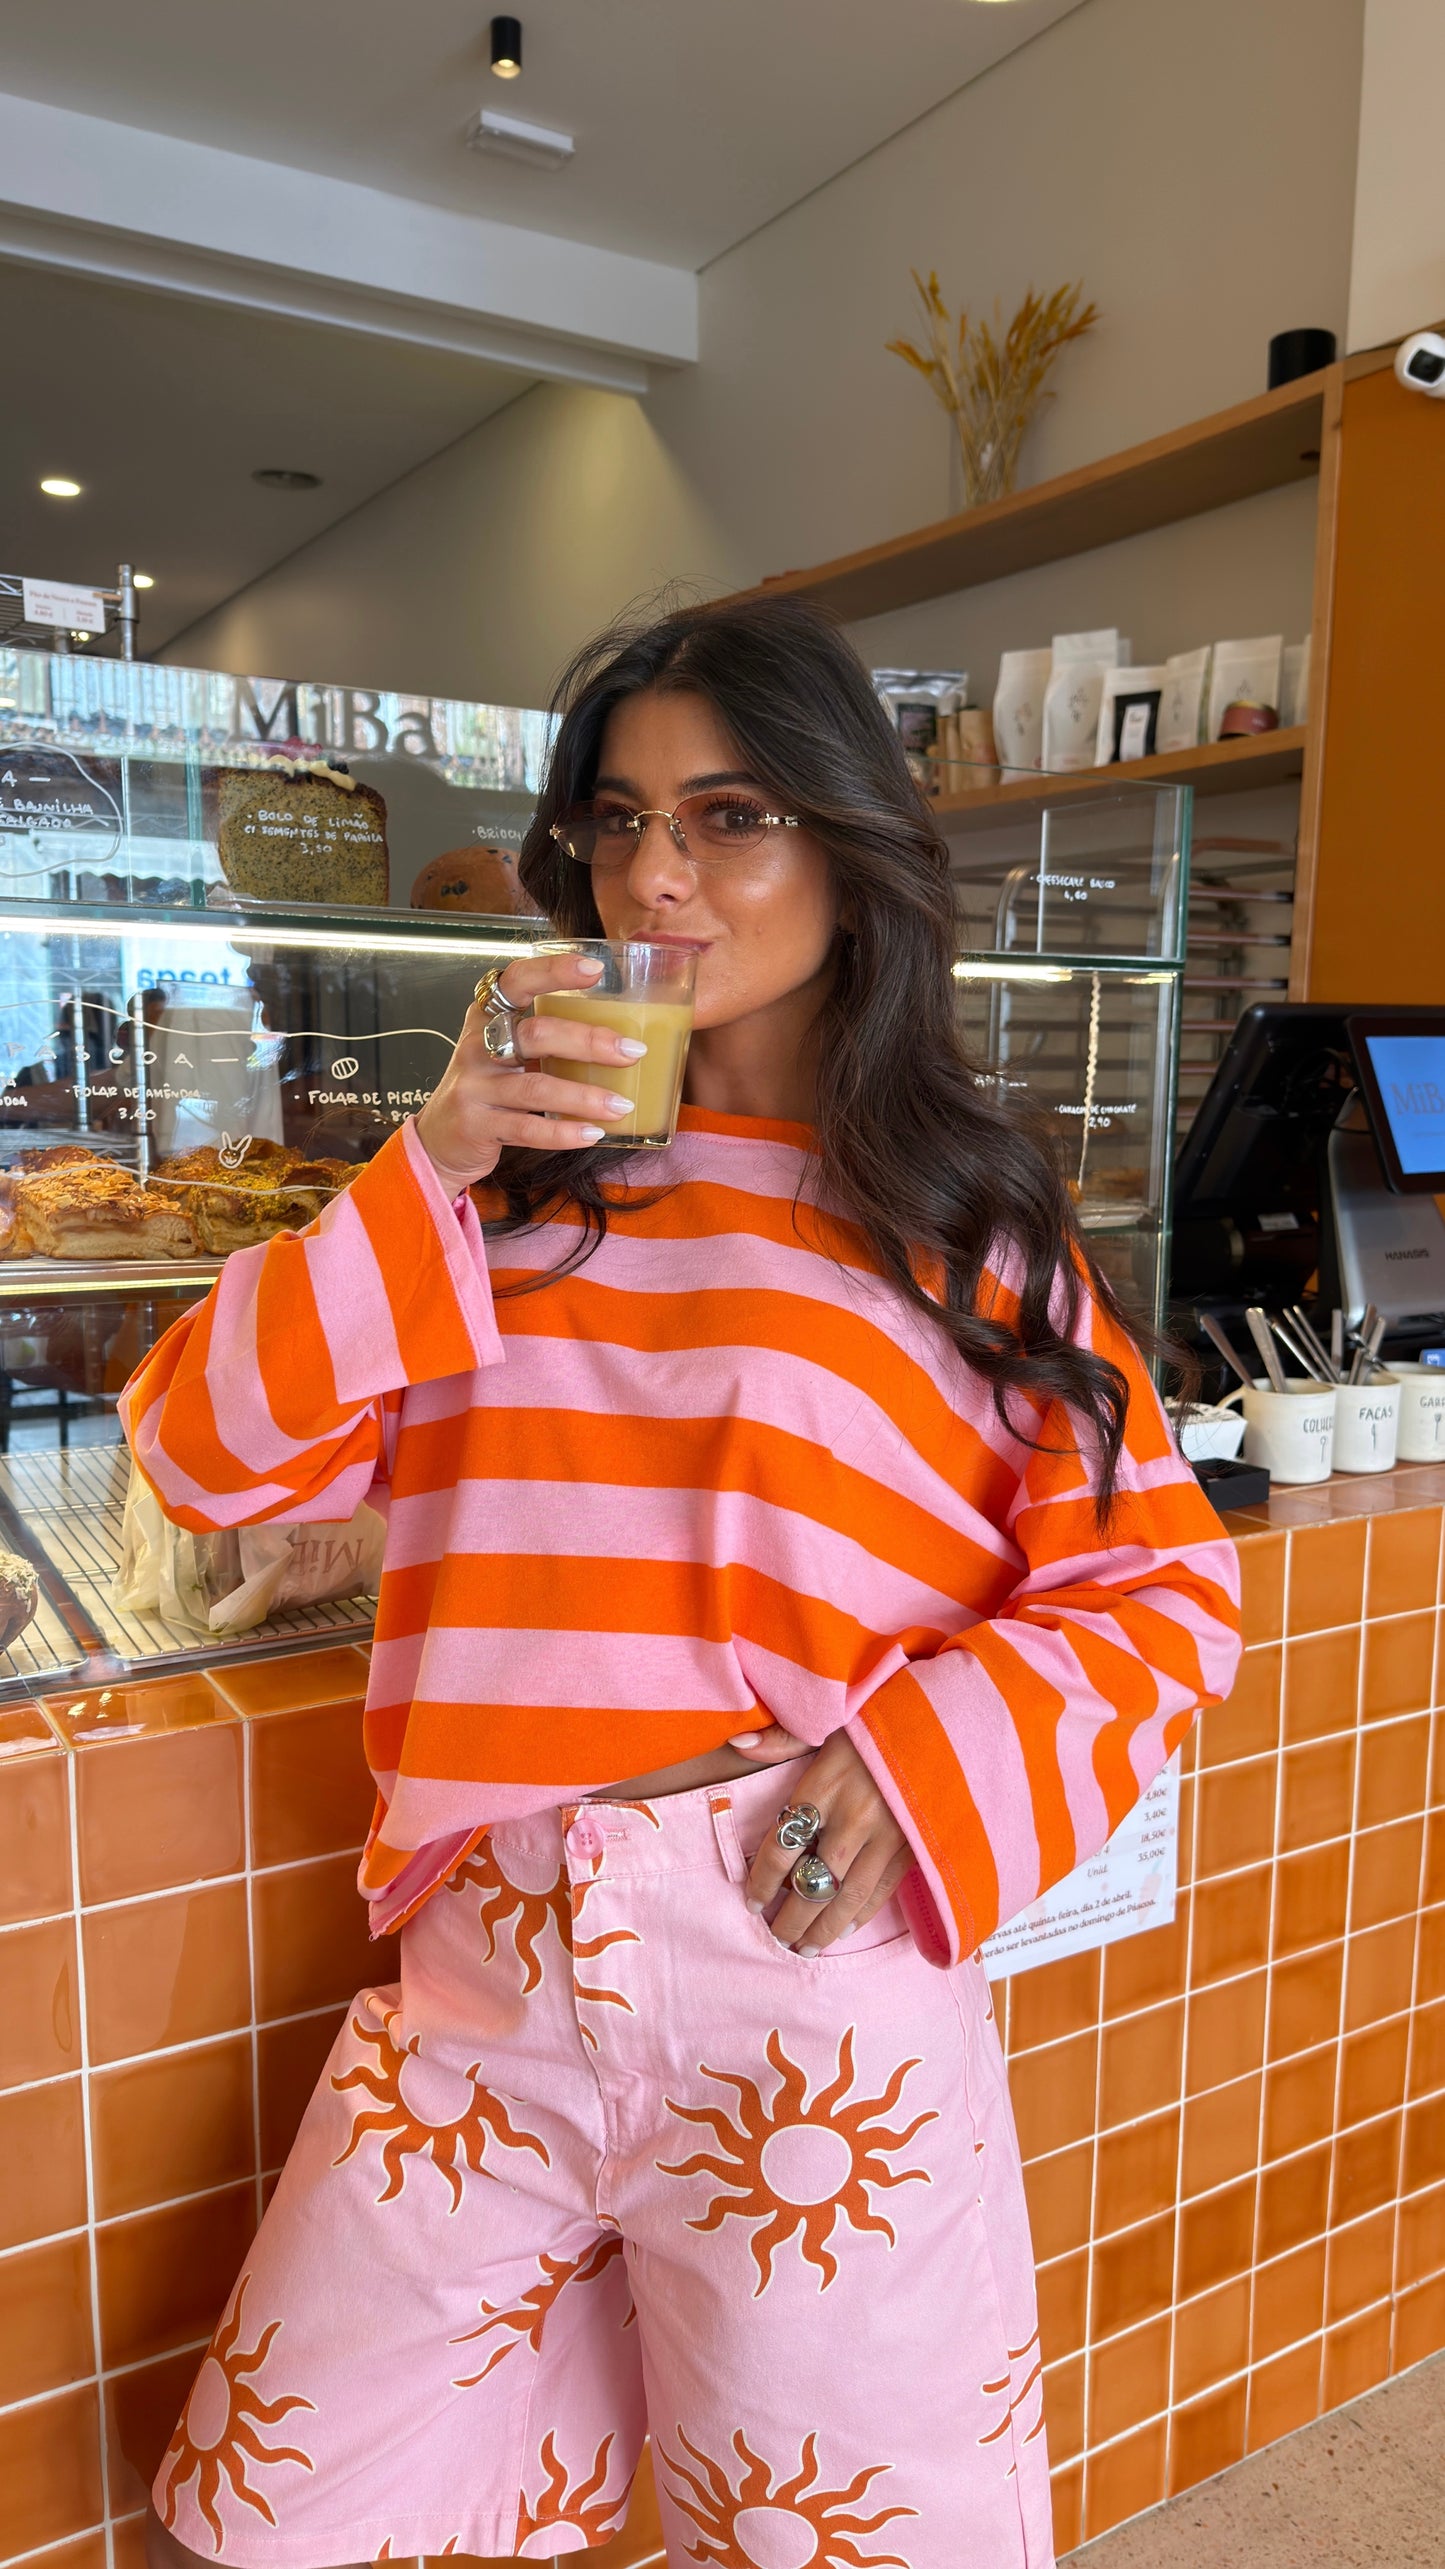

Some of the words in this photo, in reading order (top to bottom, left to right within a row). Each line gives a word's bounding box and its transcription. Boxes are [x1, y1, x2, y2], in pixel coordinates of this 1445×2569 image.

[258, 809, 294, 822] BOLO
[303, 814, 319, 828] DE
[262, 825, 320, 839] SEMENTES
[325, 831, 337, 841] DE
[300, 842, 333, 856] 3,50
[72, 1085, 118, 1099] FOLAR
[124, 1086, 140, 1098] DE
[308, 1089, 359, 1106] FOLAR
[363, 1091, 382, 1105] DE
[118, 1107, 157, 1120] 3,60
[1088, 1116, 1112, 1129] 2,90
[1359, 1405, 1393, 1420] FACAS
[1013, 1922, 1028, 1934] até
[1080, 1903, 1094, 1913] dia
[1101, 1897, 1111, 1907] de
[1006, 1941, 1020, 1951] ser
[1068, 1923, 1079, 1932] no
[1079, 1912, 1115, 1928] domingo
[1116, 1907, 1126, 1916] de
